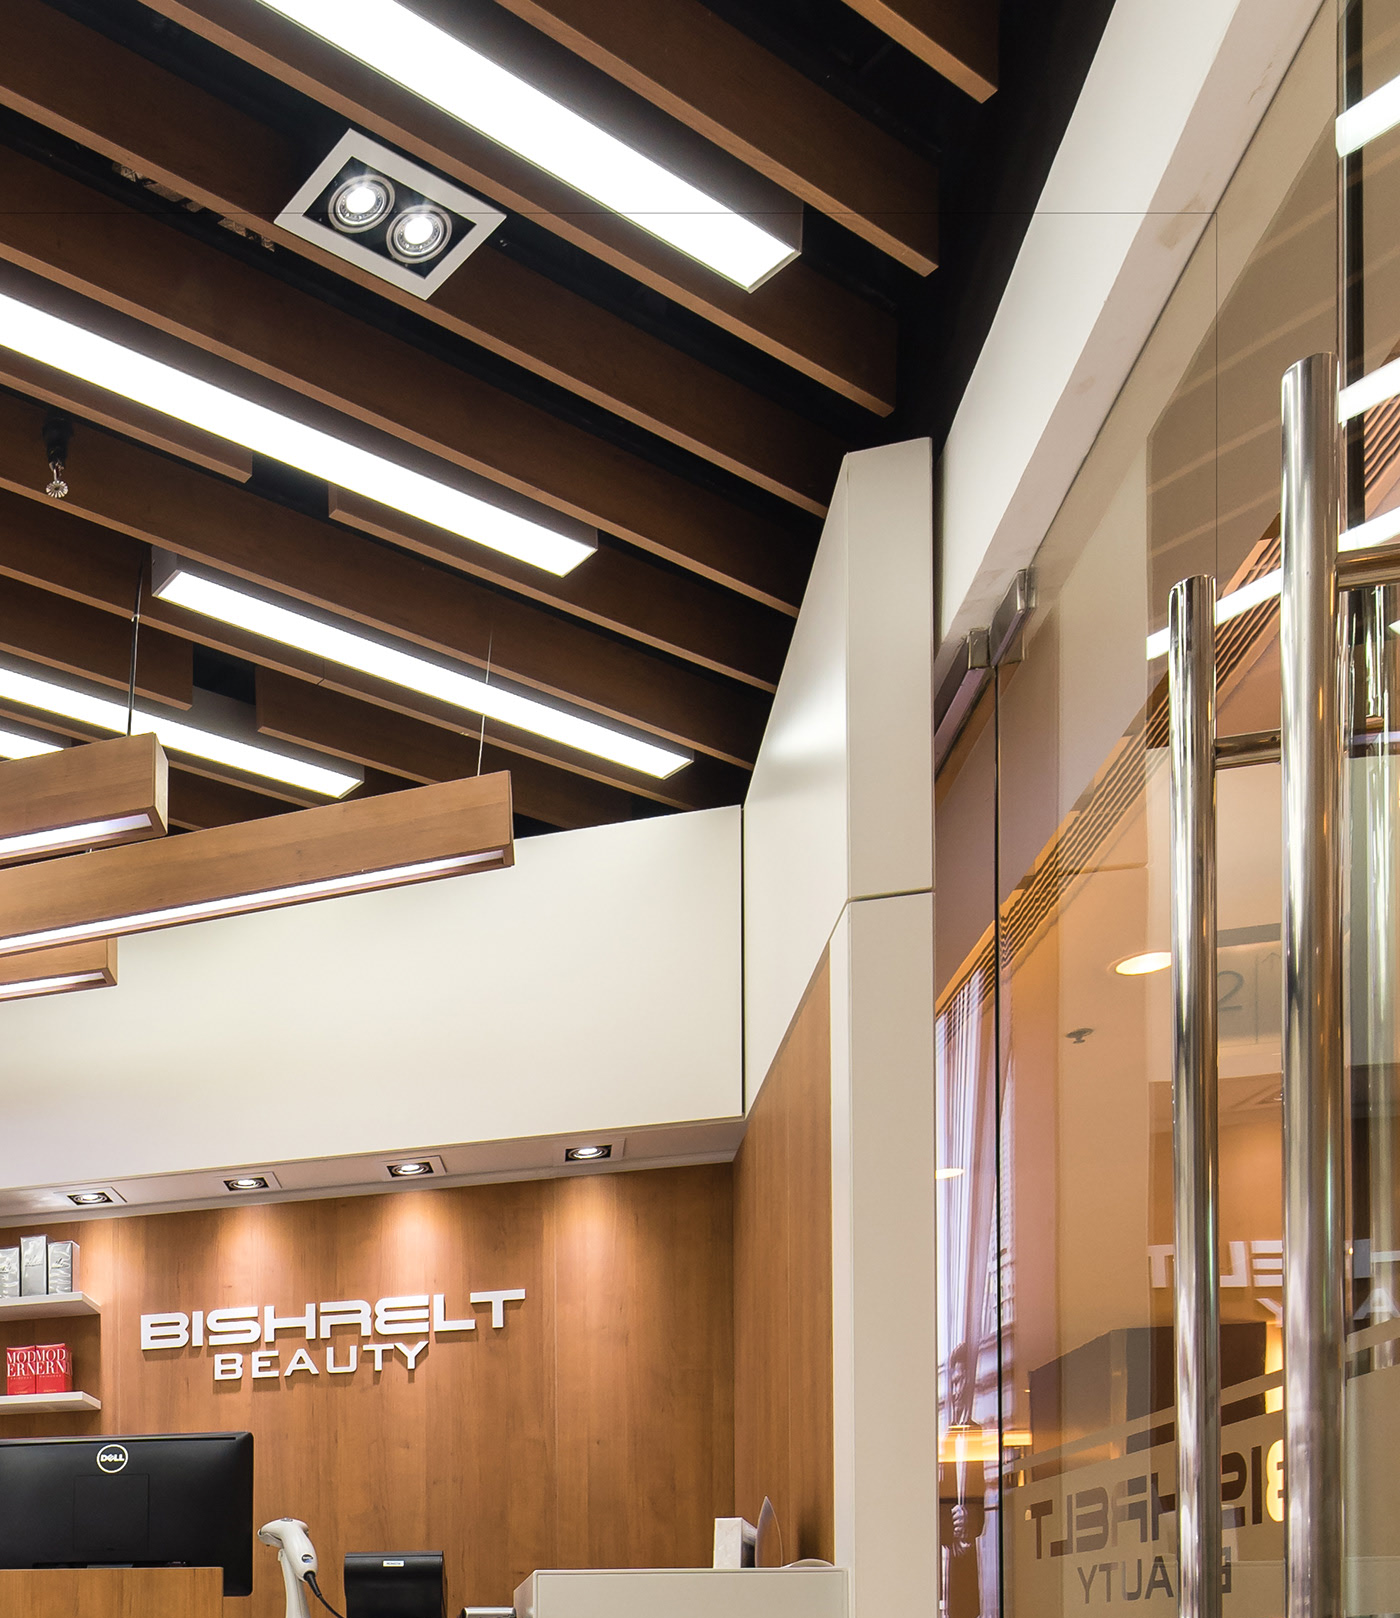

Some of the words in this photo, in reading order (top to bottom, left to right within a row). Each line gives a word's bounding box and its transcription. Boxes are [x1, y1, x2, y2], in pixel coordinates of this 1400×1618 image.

[140, 1289, 525, 1351] BISHRELT
[214, 1341, 428, 1381] BEAUTY
[100, 1453, 125, 1462] DELL
